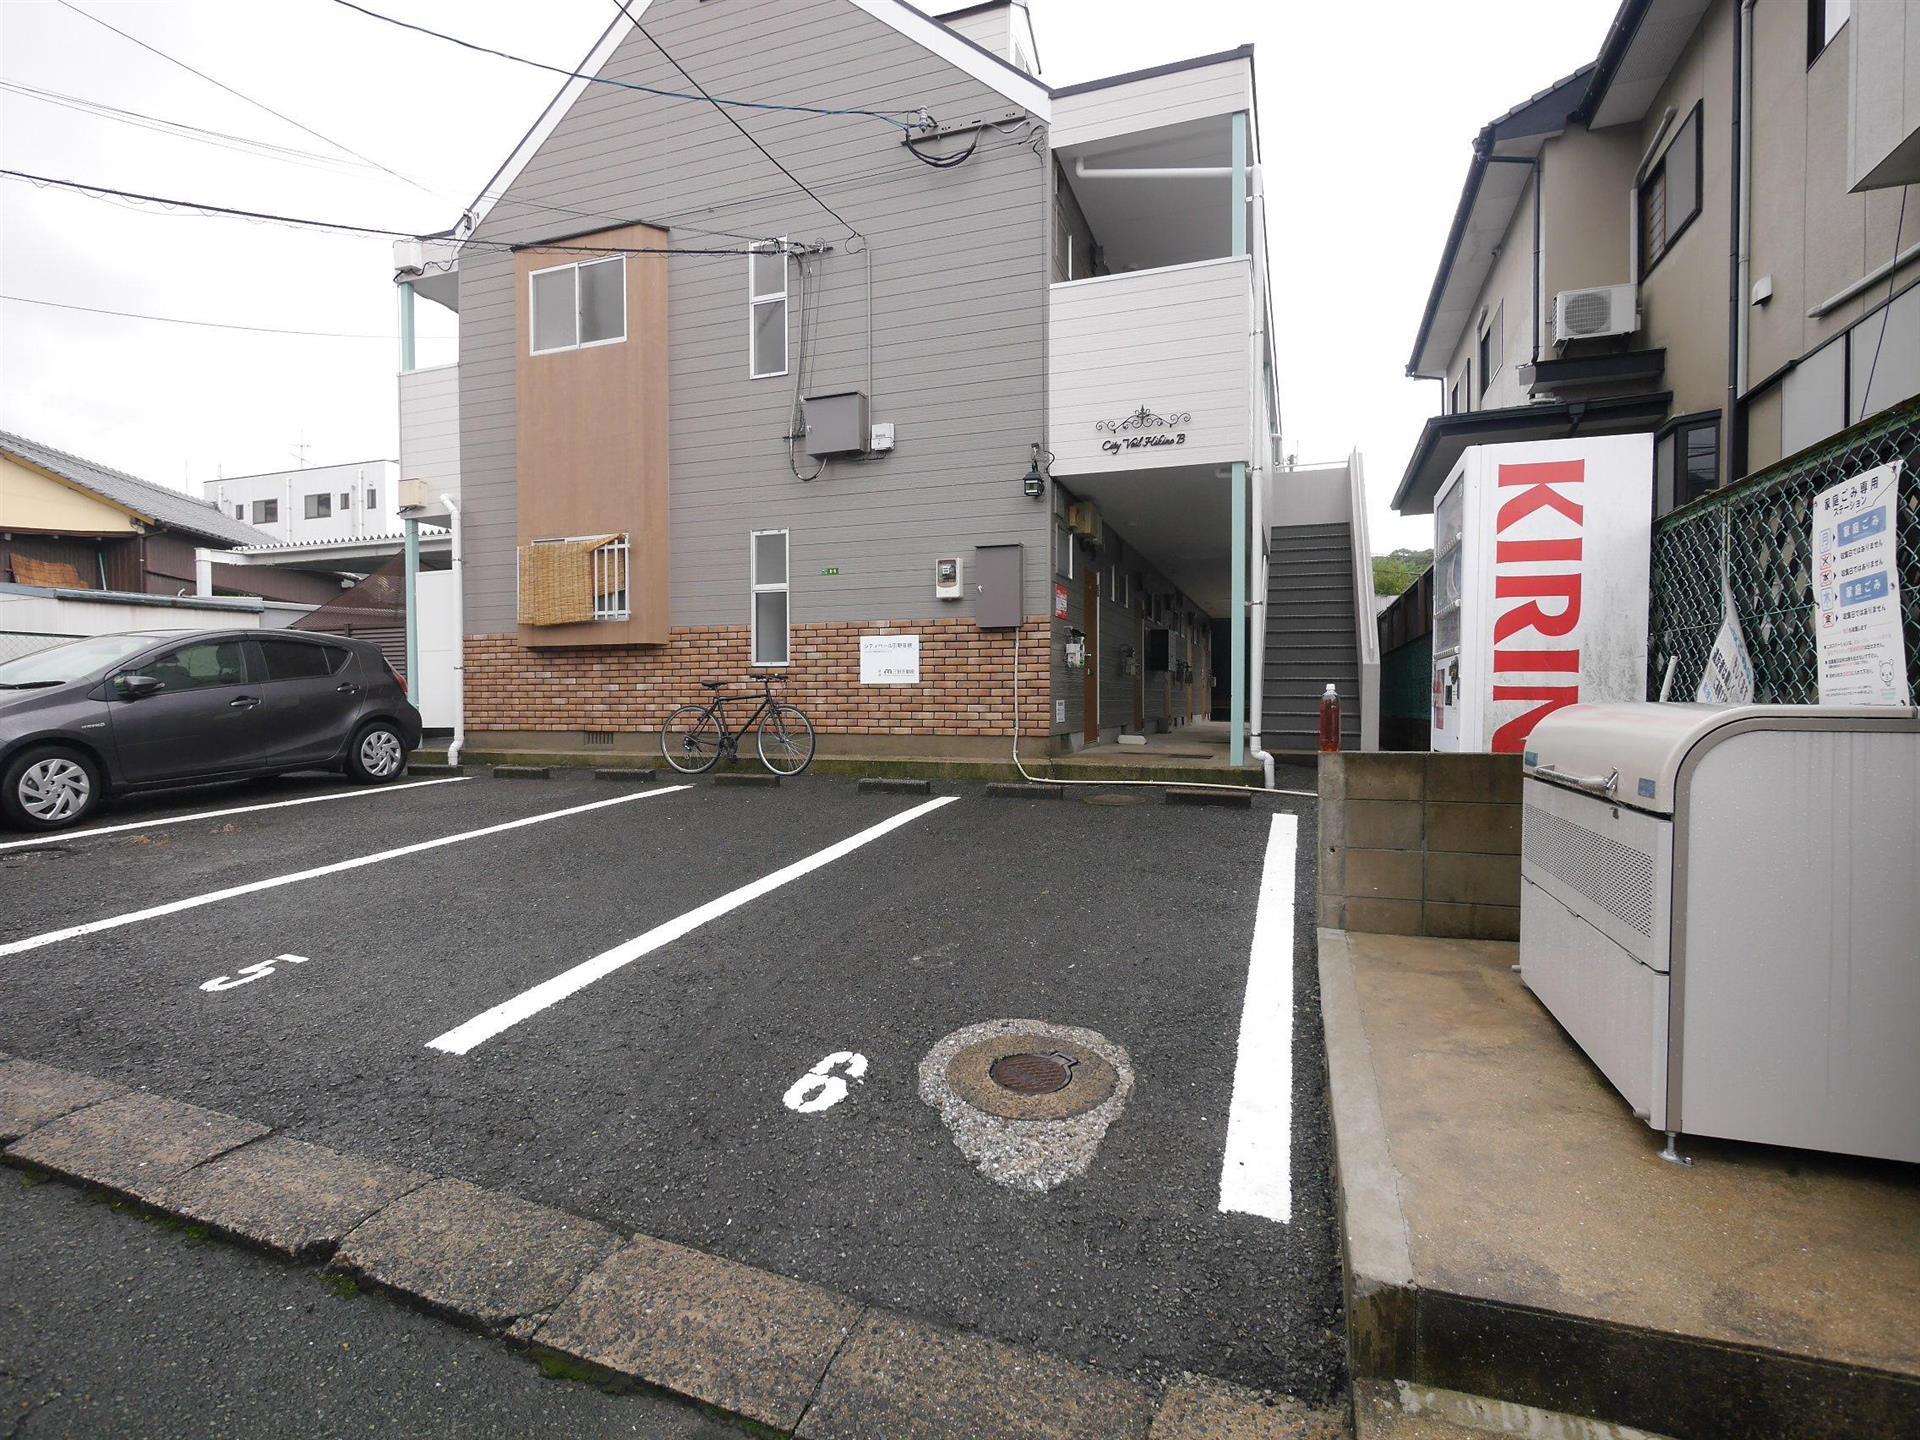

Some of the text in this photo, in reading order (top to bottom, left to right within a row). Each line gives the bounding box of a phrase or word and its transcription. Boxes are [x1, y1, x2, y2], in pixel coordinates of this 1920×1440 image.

[1102, 440, 1122, 455] City
[1176, 433, 1186, 444] B
[1824, 476, 1879, 510] 家庭ごみ専用
[1833, 496, 1867, 518] ステーション
[1492, 458, 1585, 752] KIRIN
[199, 953, 309, 992] 5
[782, 1051, 868, 1113] 6
